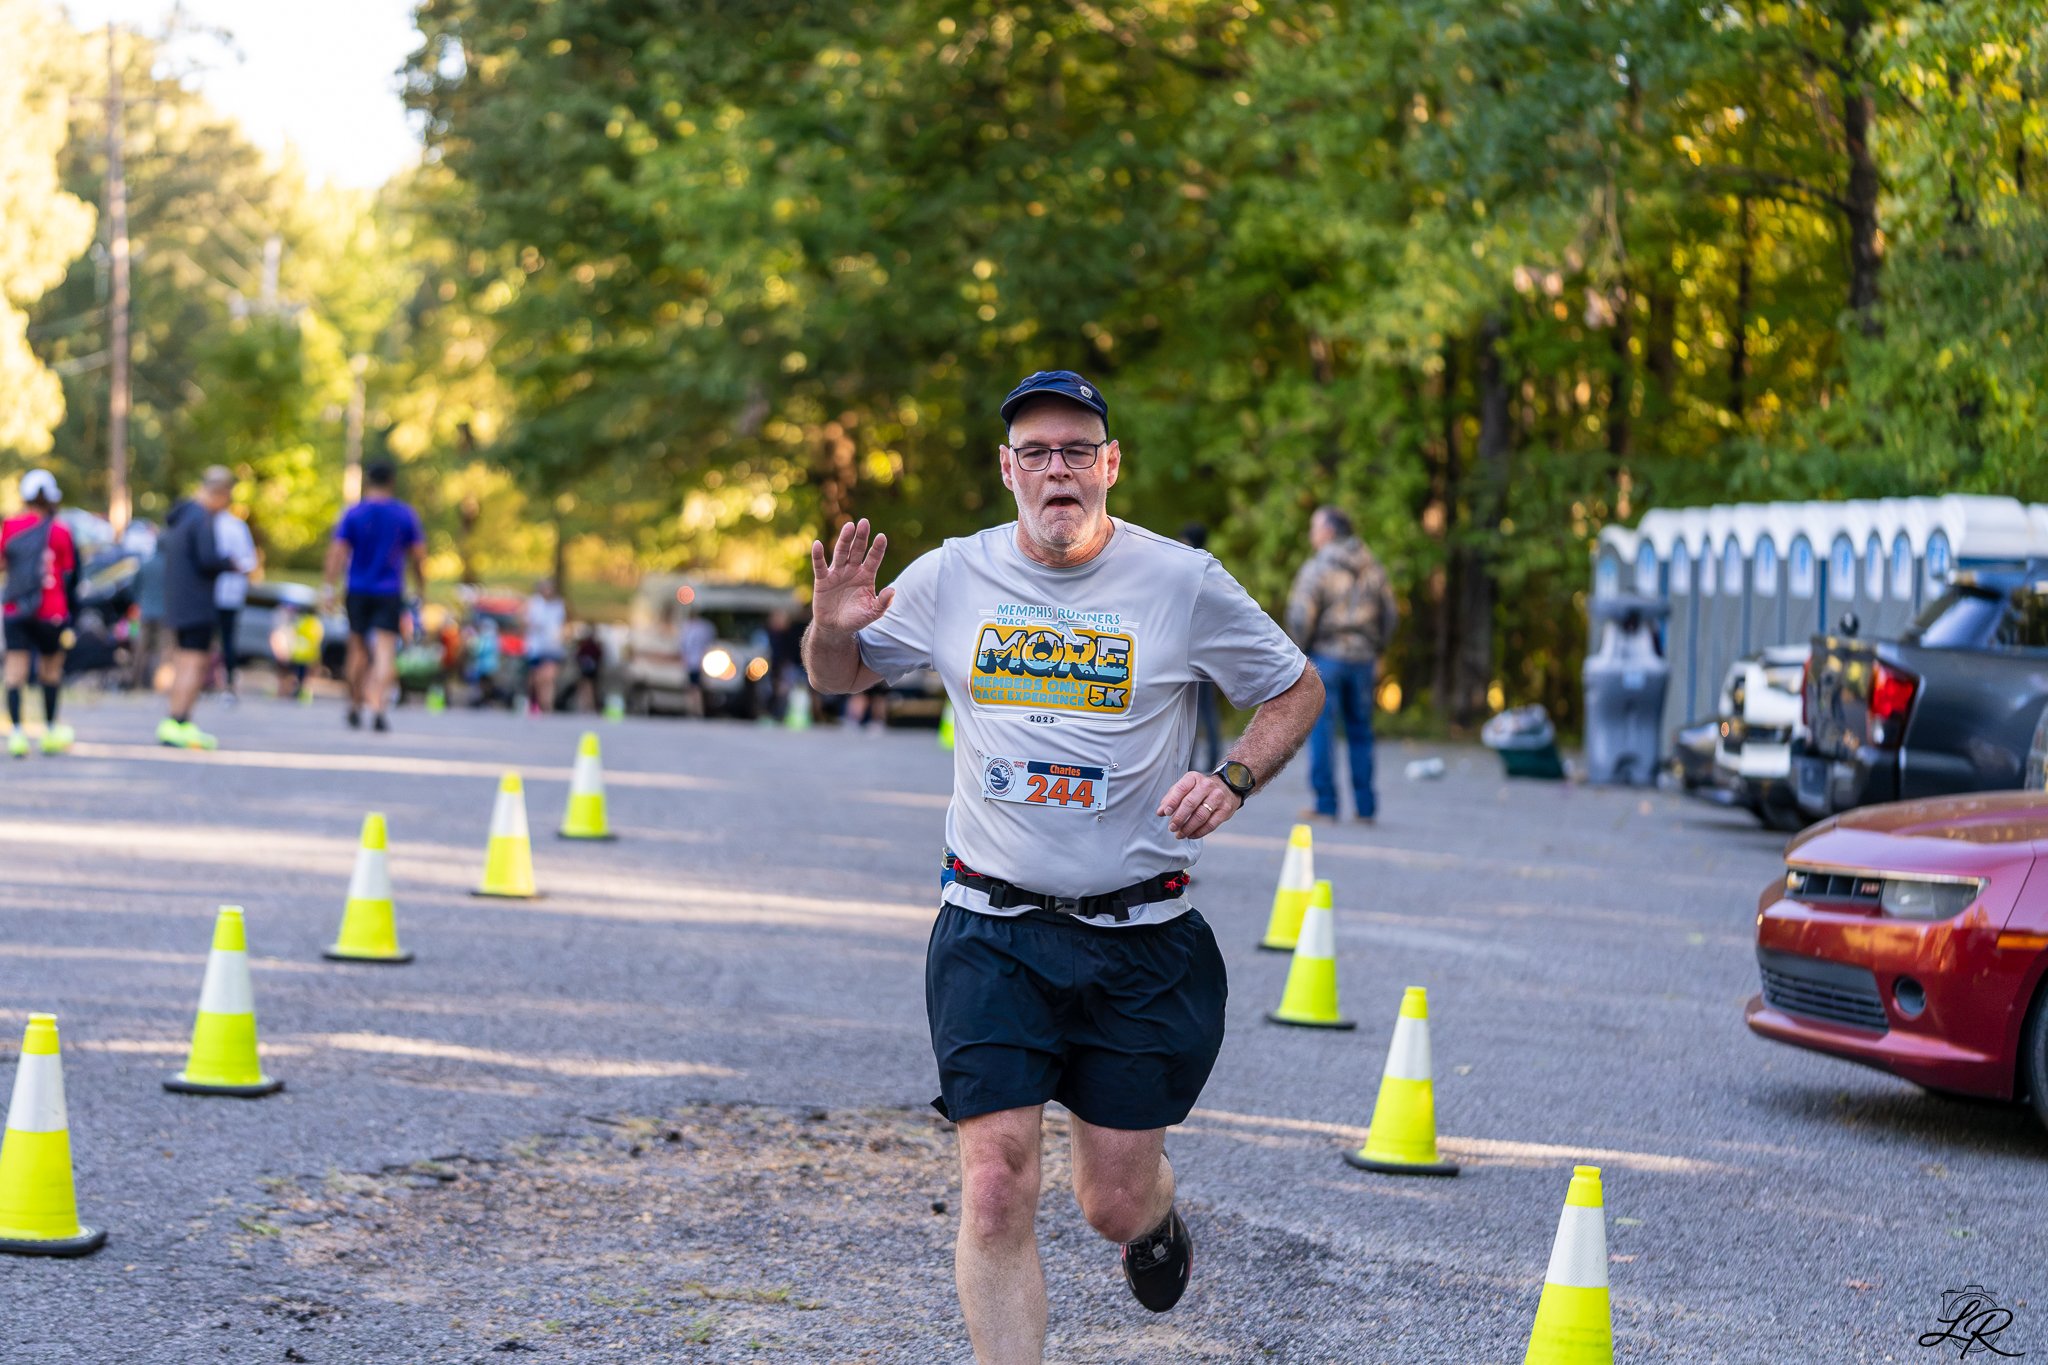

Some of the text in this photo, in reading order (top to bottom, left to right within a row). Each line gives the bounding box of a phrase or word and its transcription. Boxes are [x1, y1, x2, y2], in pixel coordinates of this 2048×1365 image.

[997, 604, 1120, 625] MEMPHIS RUNNERS
[996, 617, 1120, 634] TRACK CLUB
[976, 628, 1131, 685] MORE
[973, 676, 1089, 695] MEMBERS ONLY
[973, 689, 1086, 707] RACE EXPERIENCE
[1087, 684, 1129, 708] 5K
[1029, 715, 1055, 724] 2025
[1049, 764, 1081, 777] Charles
[1024, 774, 1095, 808] 244
